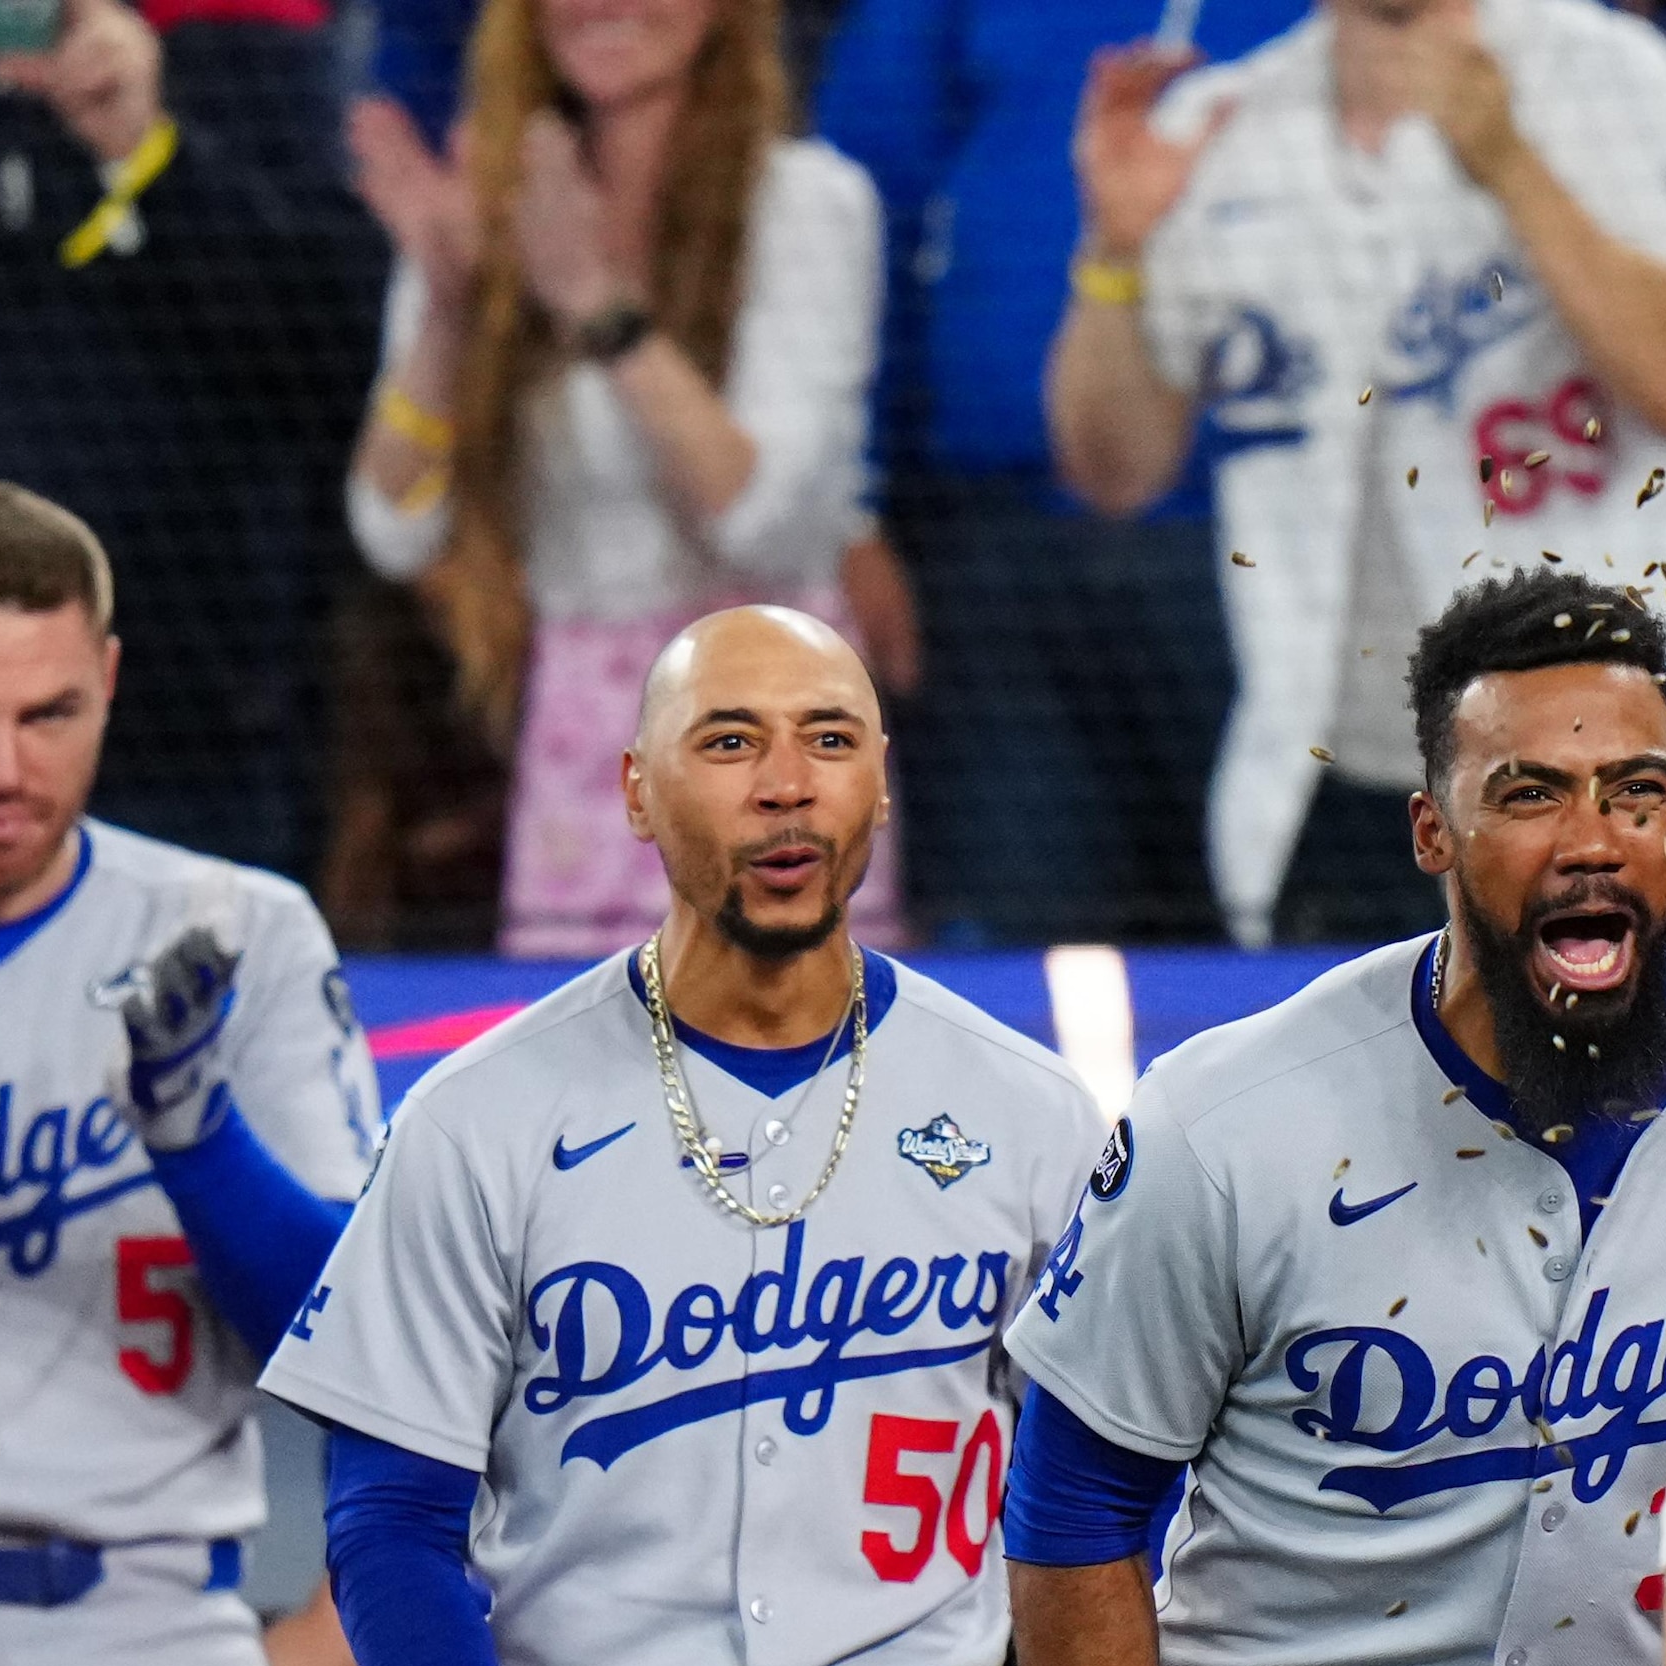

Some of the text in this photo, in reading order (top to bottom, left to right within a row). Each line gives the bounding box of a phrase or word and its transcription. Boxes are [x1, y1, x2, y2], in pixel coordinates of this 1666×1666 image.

[116, 1235, 194, 1396] 5
[524, 1219, 1011, 1440] Dodgers
[860, 1409, 1000, 1584] 50
